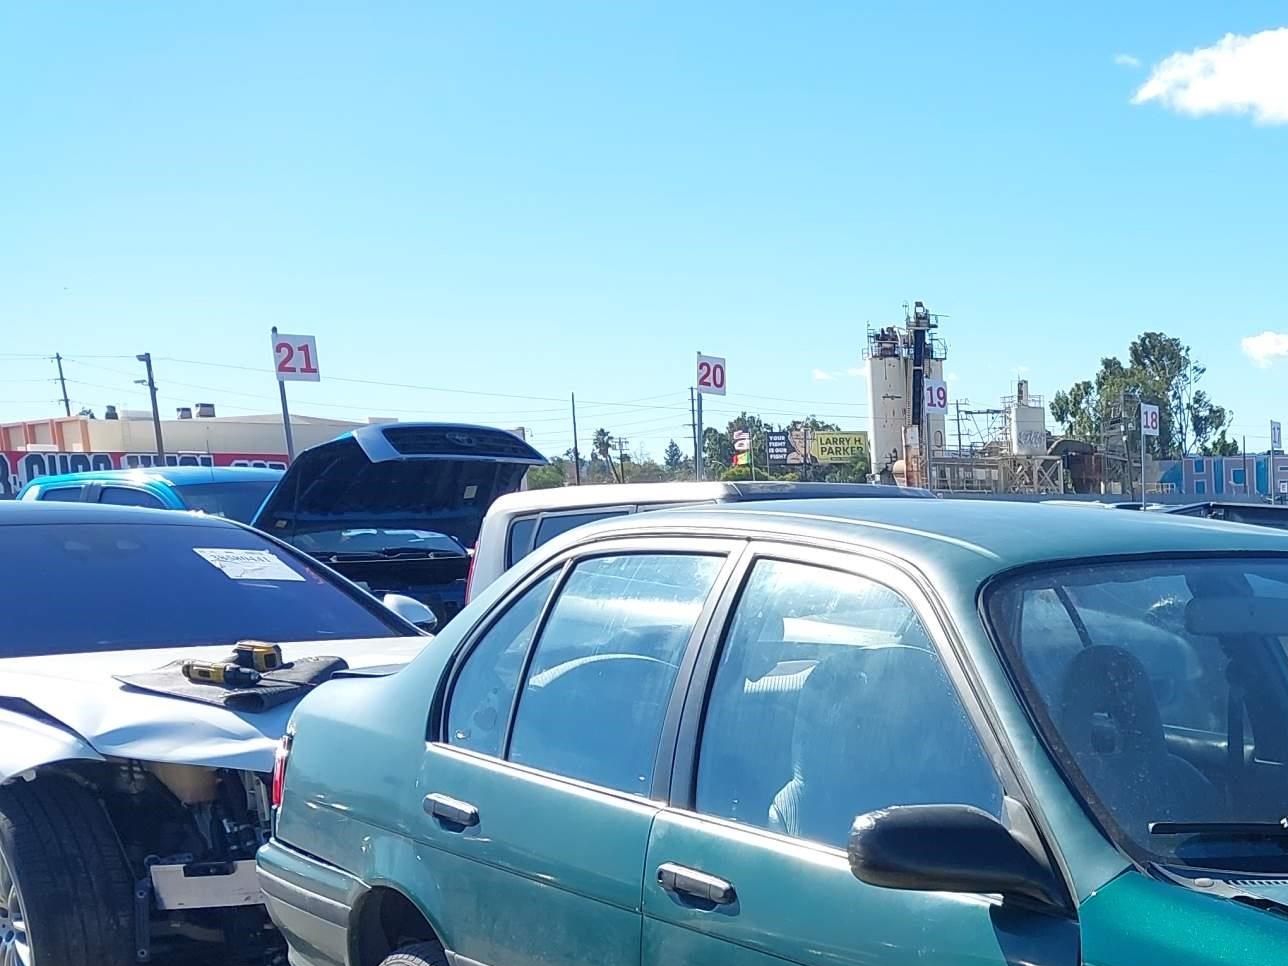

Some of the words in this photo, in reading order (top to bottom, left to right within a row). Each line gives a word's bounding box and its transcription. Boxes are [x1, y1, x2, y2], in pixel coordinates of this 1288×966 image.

[275, 342, 318, 373] 21
[698, 361, 725, 388] 20
[926, 386, 947, 408] 19
[1143, 410, 1158, 430] 18
[820, 437, 850, 445] LARRY
[854, 437, 864, 445] H.
[820, 446, 863, 455] PARKER
